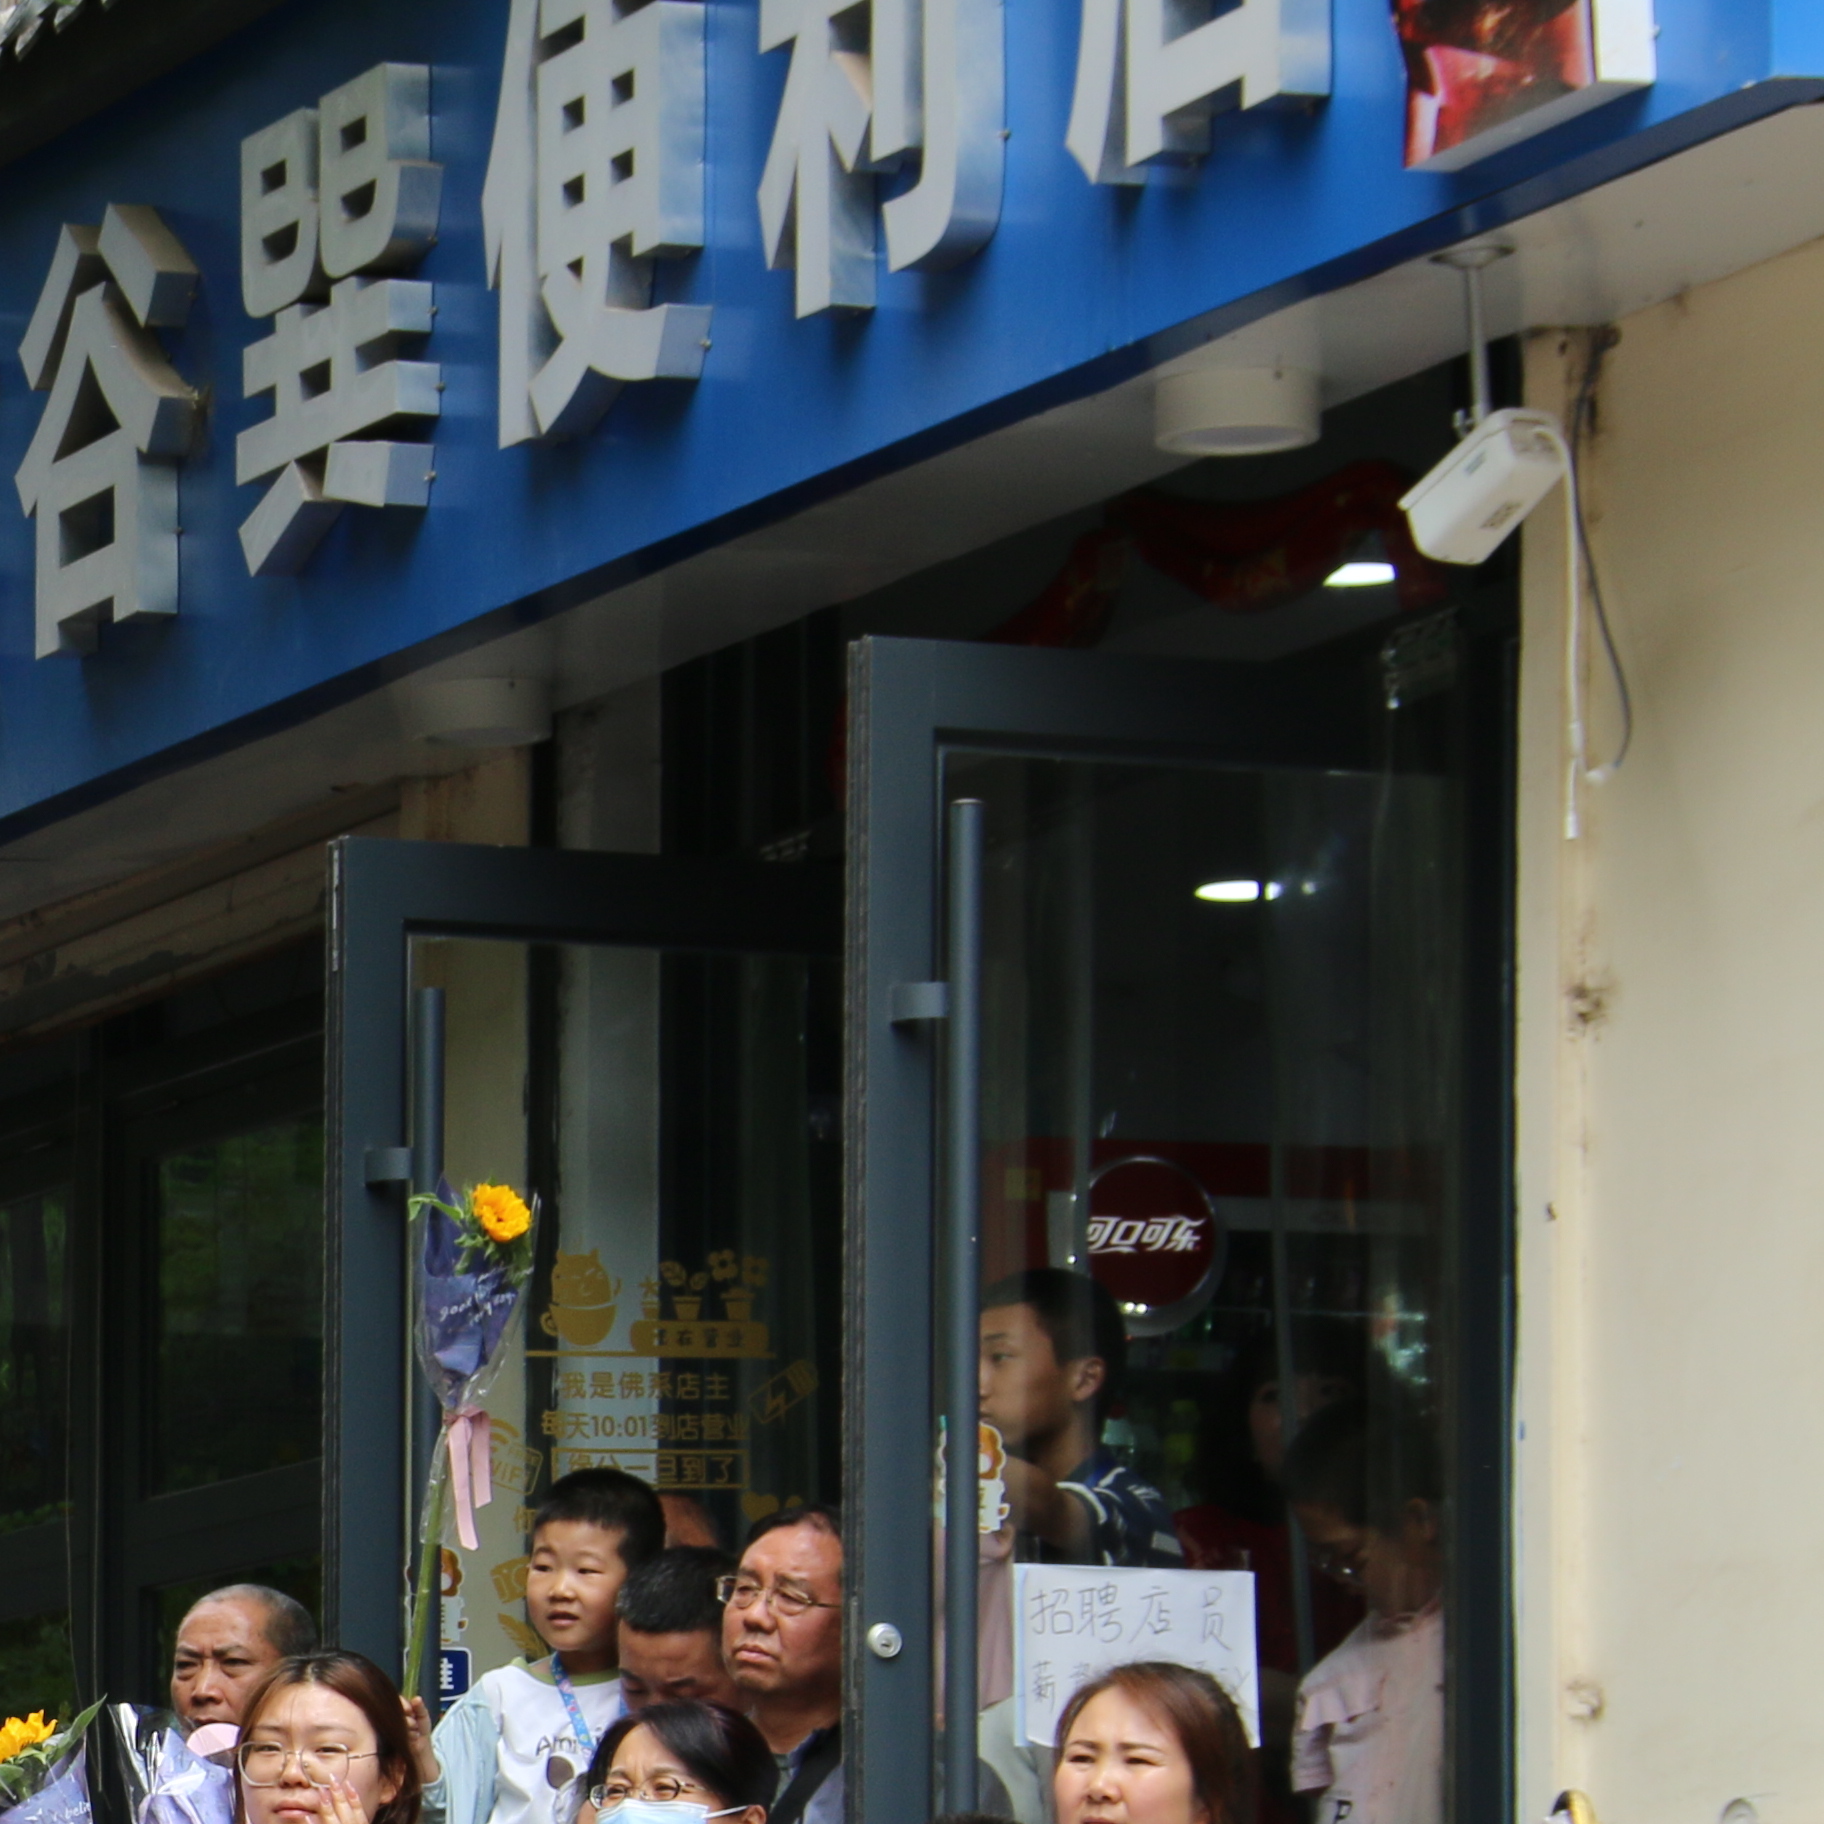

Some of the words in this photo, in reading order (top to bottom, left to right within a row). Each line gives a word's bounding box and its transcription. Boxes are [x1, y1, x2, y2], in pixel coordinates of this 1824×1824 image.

[1087, 1216, 1205, 1253] 可口可乐
[560, 1371, 731, 1400] 我是佛系店主
[1029, 1583, 1234, 1652] 招聘店员
